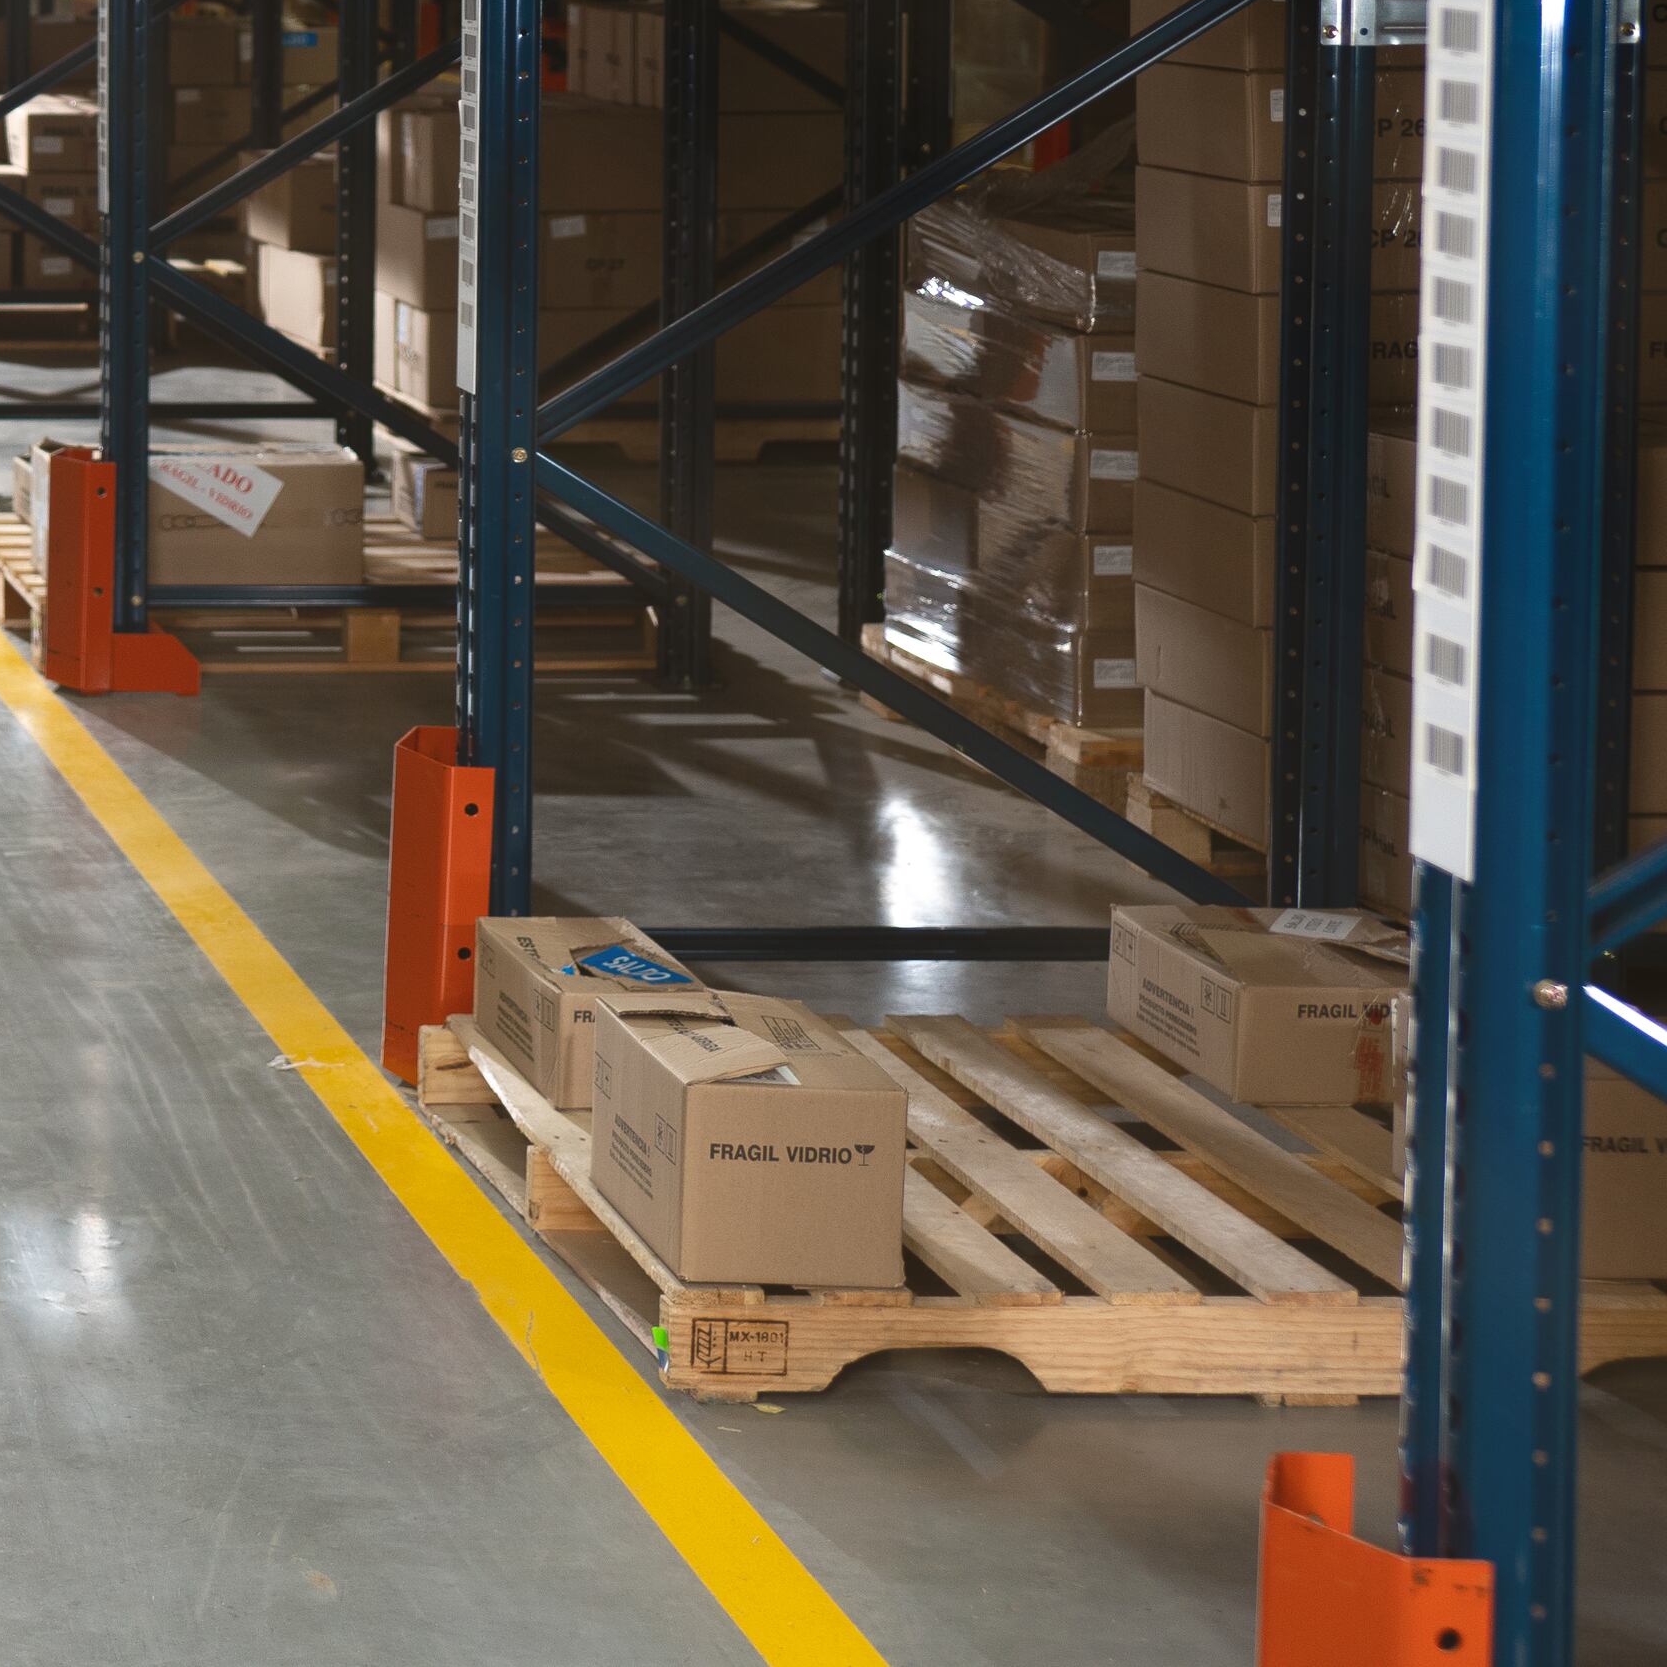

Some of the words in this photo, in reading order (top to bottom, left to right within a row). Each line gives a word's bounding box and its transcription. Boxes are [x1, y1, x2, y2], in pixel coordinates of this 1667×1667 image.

[612, 953, 671, 982] SALDO
[1297, 1004, 1357, 1019] FRAGIL
[710, 1143, 779, 1162] FRAGIL
[786, 1145, 852, 1164] VIDRIO
[729, 1331, 784, 1343] MX-1801
